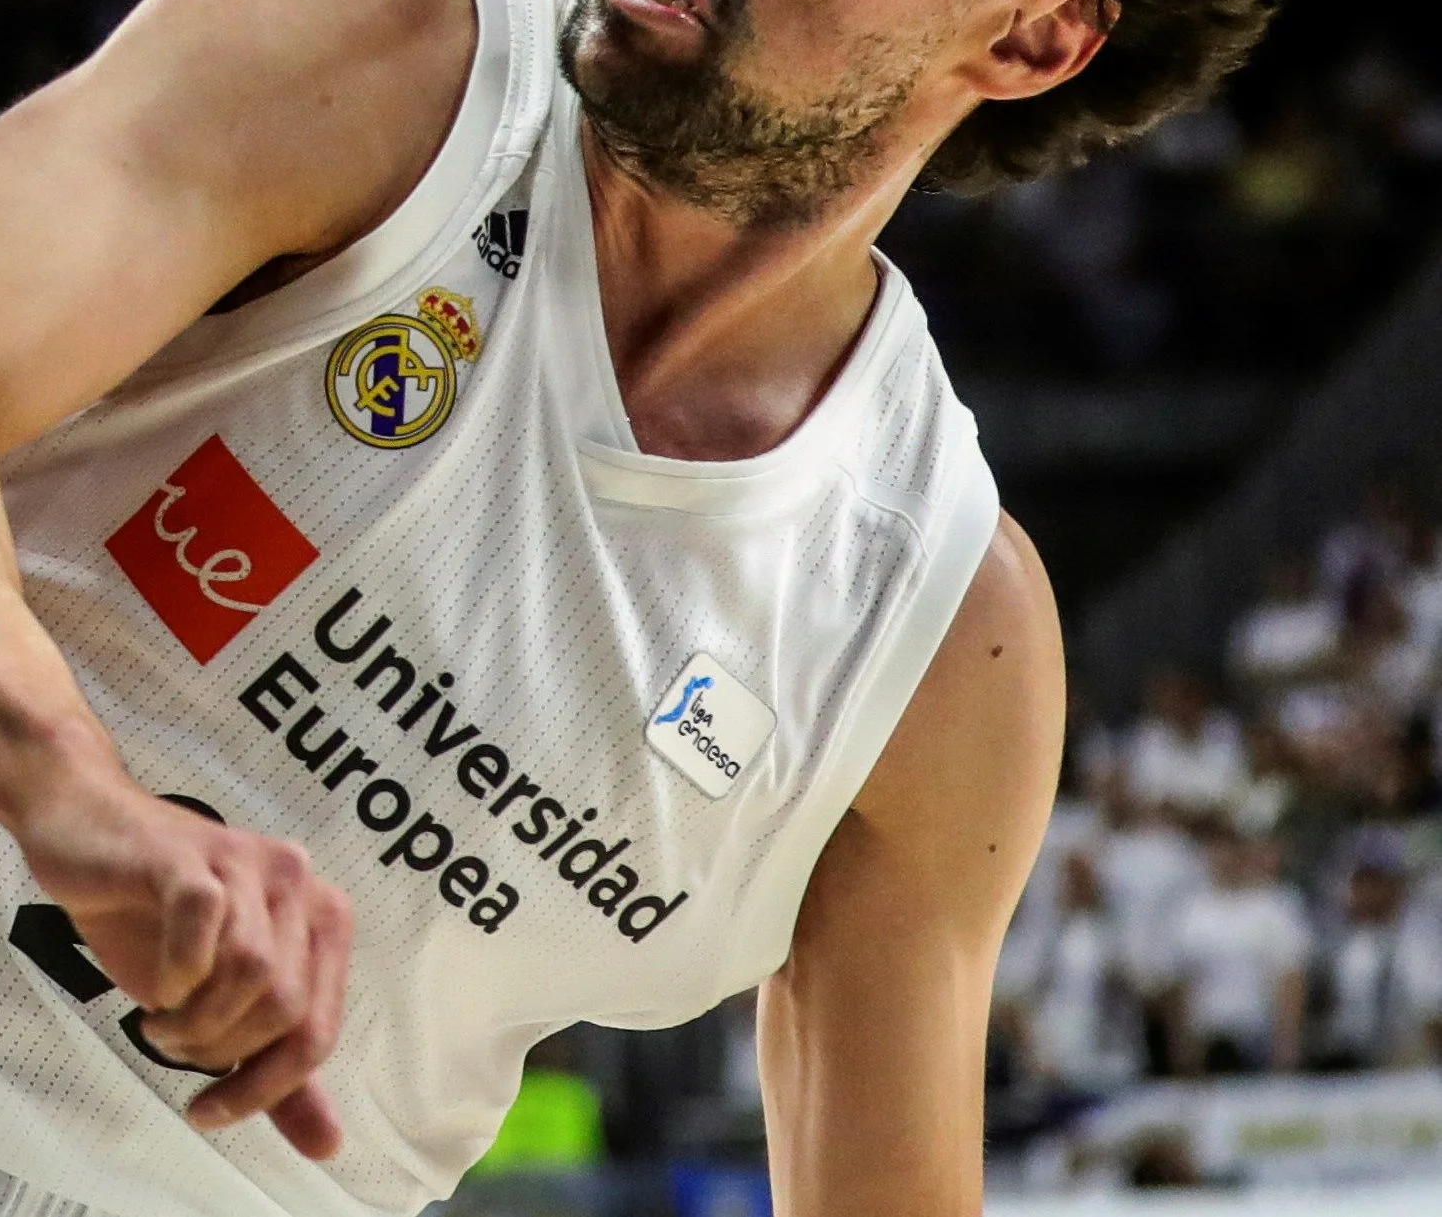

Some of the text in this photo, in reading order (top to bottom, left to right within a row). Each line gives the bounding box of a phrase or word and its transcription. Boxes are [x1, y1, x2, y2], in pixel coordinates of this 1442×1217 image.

[238, 651, 521, 935] Europea
[314, 586, 690, 943] Universidad
[677, 719, 741, 780] endesa
[689, 690, 715, 728] liga
